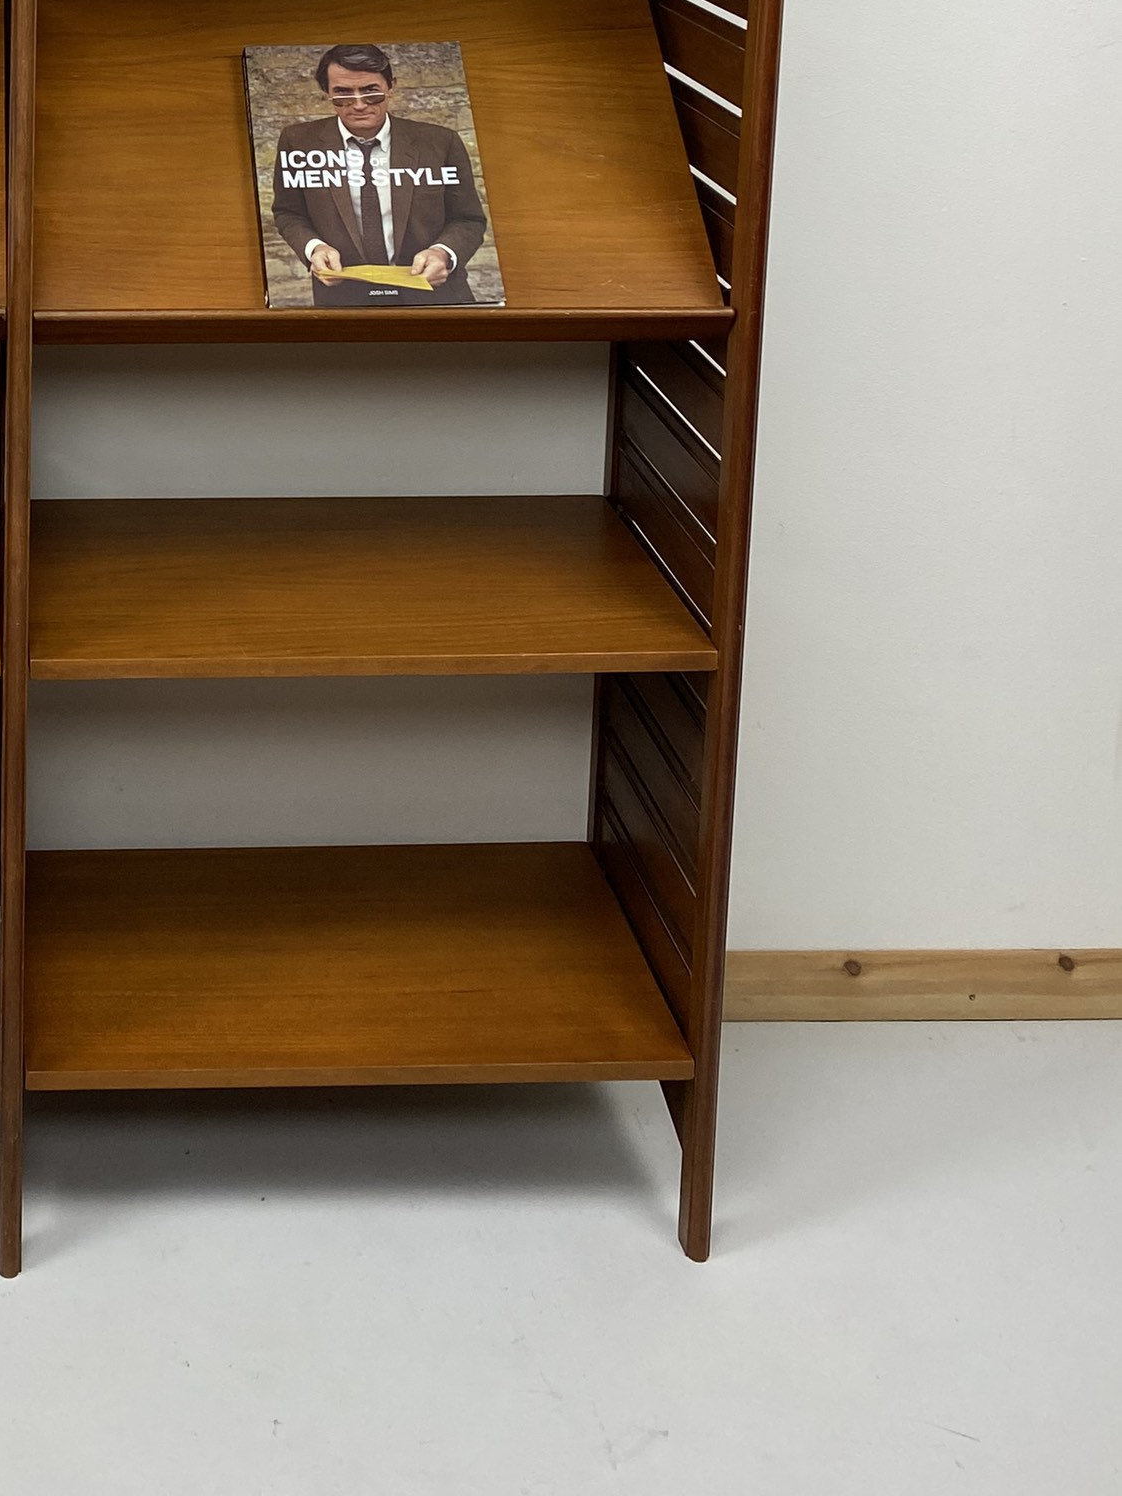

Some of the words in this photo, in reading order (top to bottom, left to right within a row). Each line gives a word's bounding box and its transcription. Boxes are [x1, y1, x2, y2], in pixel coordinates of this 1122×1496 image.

[279, 149, 365, 169] ICONS
[370, 157, 388, 168] OF
[282, 169, 366, 189] MEN'S
[370, 166, 460, 187] STYLE
